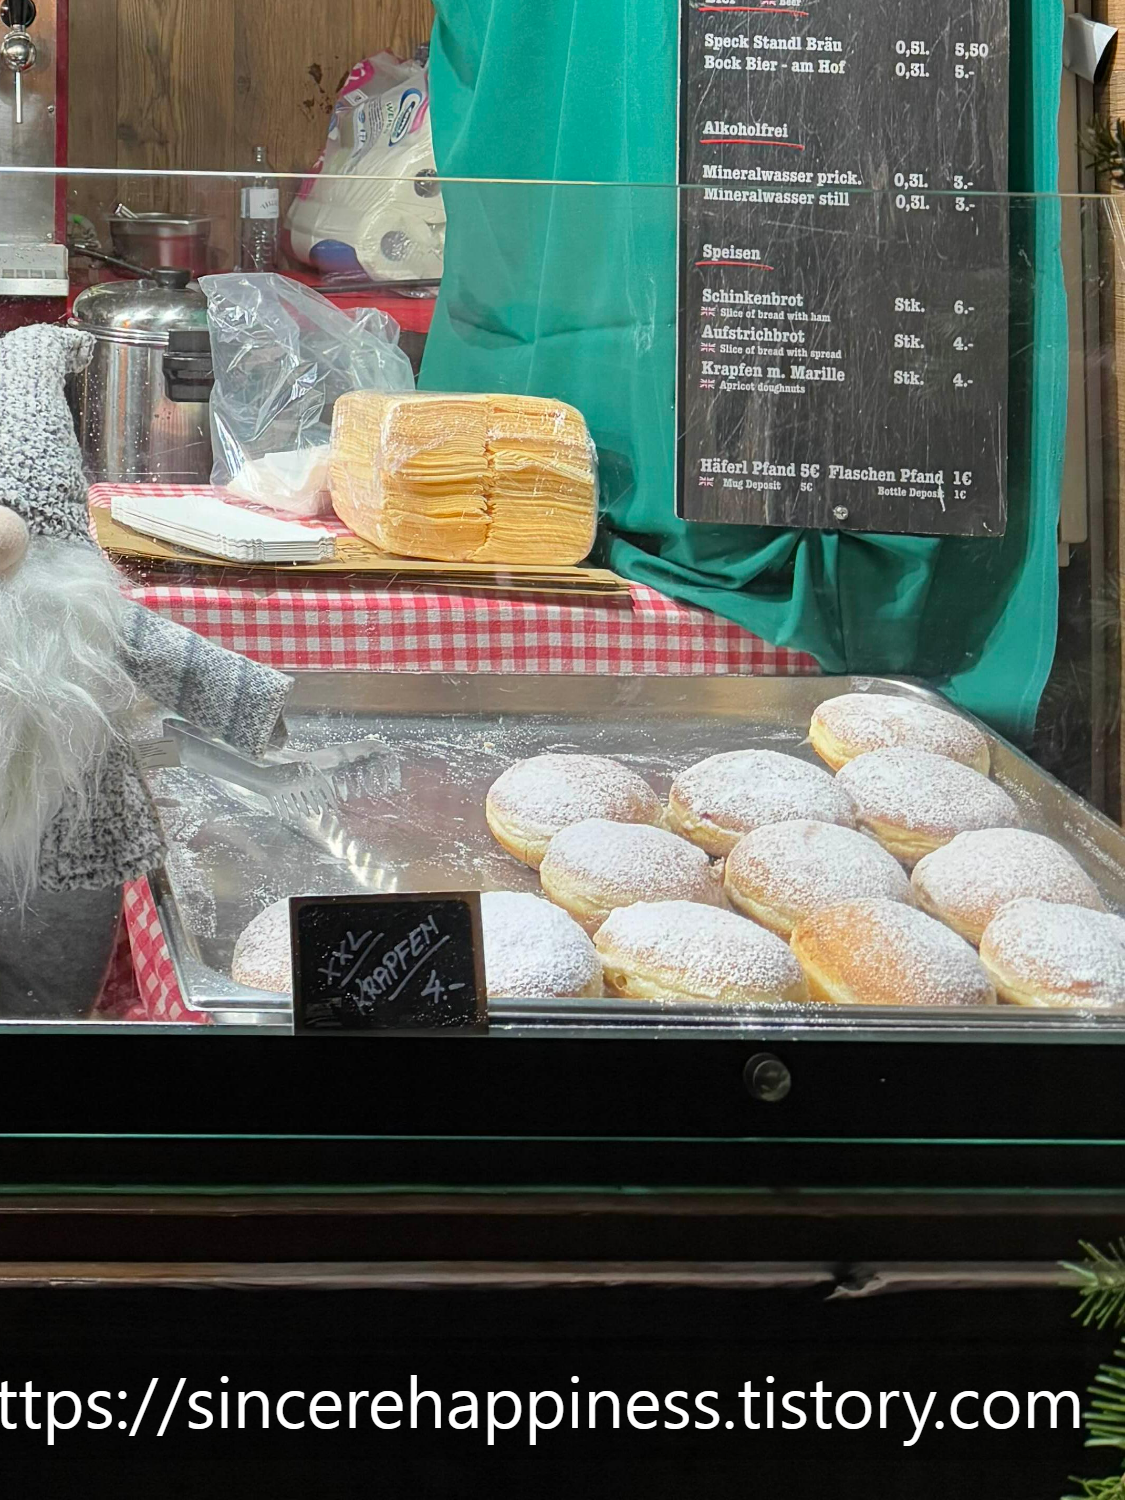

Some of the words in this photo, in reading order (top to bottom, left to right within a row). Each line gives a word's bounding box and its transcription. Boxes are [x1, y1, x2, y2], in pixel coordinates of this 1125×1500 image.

[705, 34, 749, 50] Speck
[753, 35, 802, 51] Standl
[806, 36, 842, 52] Bräu
[955, 42, 988, 58] 5,50
[704, 56, 741, 70] Bock
[745, 56, 777, 71] Bier
[791, 61, 813, 72] am
[818, 59, 845, 74] Hof
[955, 64, 975, 79] 5.-
[703, 121, 788, 138] Alkoholfrei
[702, 165, 813, 184] Mineralwasser
[817, 170, 862, 186] prick.
[954, 175, 974, 190] 3.-
[704, 188, 814, 205] Mineralwasser
[819, 191, 849, 207] still
[955, 198, 975, 212] 3.-
[702, 244, 761, 261] Speisen
[702, 289, 803, 306] Schinkenbrot
[720, 308, 742, 318] Slice
[746, 308, 756, 318] of
[758, 309, 784, 320] bread
[787, 311, 808, 321] with
[811, 313, 830, 322] ham
[895, 298, 925, 313] Stk.
[954, 301, 974, 315] 6.-
[702, 326, 804, 343] Aufstrichbrot
[895, 334, 924, 349] Stk.
[953, 337, 974, 351] 4.-
[720, 345, 742, 355] Slice
[745, 345, 755, 355] of
[758, 346, 784, 356] bread
[787, 347, 808, 358] with
[810, 349, 841, 359] spread
[701, 362, 762, 380] Krapfen
[767, 368, 785, 379] m.
[790, 365, 845, 382] Marille
[894, 371, 924, 386] Stk.
[953, 374, 973, 388] 4.-
[719, 381, 752, 392] Apricot
[757, 382, 805, 395] doughnuts
[700, 459, 747, 475] Häferl
[752, 461, 795, 477] Pfand
[800, 463, 820, 478] 5€
[829, 464, 895, 482] Flaschen
[900, 468, 944, 484] Pfand
[953, 471, 972, 486] 1€
[723, 479, 742, 491] Mug
[745, 480, 781, 491] Deposit
[800, 482, 813, 492] 5€
[878, 486, 906, 497] Bottle
[909, 488, 944, 499] Deposit
[954, 490, 966, 500] 1€
[318, 930, 373, 985] XXL
[352, 915, 439, 1015] KRAPFEN
